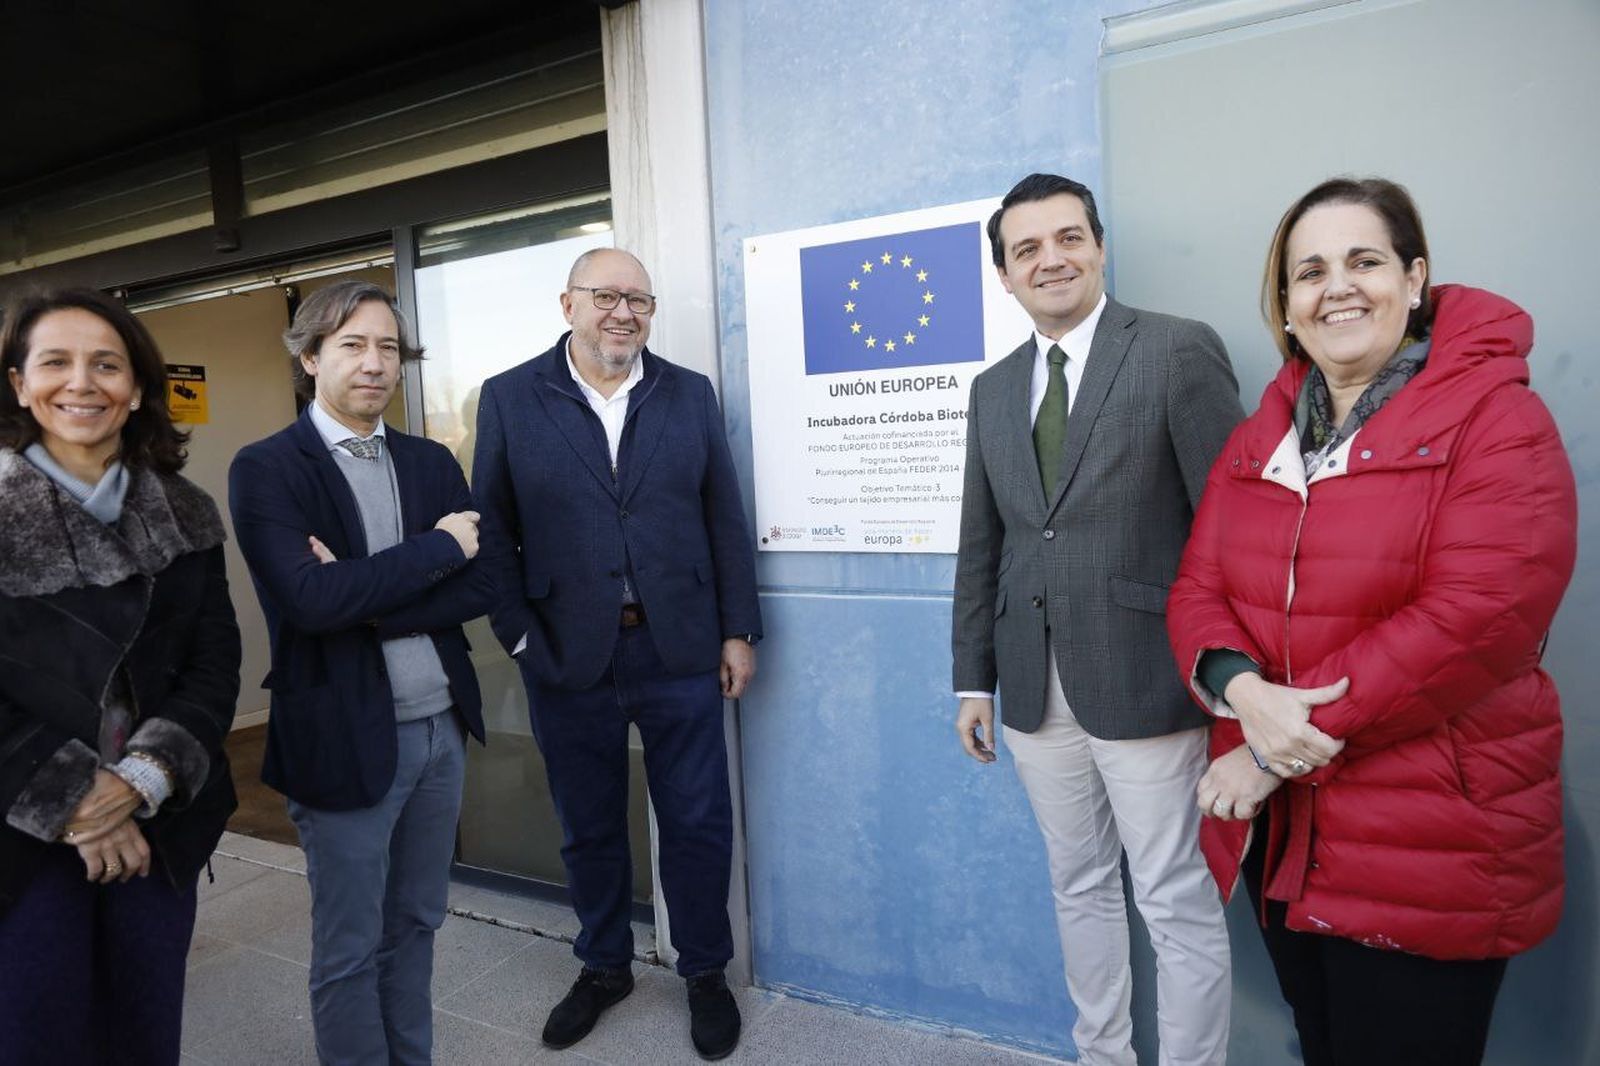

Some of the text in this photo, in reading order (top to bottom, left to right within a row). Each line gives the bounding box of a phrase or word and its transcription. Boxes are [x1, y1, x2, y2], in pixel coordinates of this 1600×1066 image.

[829, 376, 958, 397] UNIÓN EUROPEA
[808, 416, 876, 428] Incubadora
[880, 412, 934, 424] Córdoba
[843, 432, 880, 440] Actuación
[882, 430, 933, 440] cofinanciada
[935, 430, 948, 439] por
[840, 442, 877, 452] EUROPEO
[880, 442, 890, 450] DE
[892, 440, 948, 449] DESARROLLO
[860, 455, 940, 465] Programa Operativo
[878, 466, 908, 475] España
[910, 465, 936, 473] FEDER
[939, 464, 960, 472] 2014
[860, 484, 940, 494] Objetivo Temático 3
[859, 496, 882, 504] tejido
[883, 495, 930, 504] empresarial
[864, 536, 902, 546] europa
